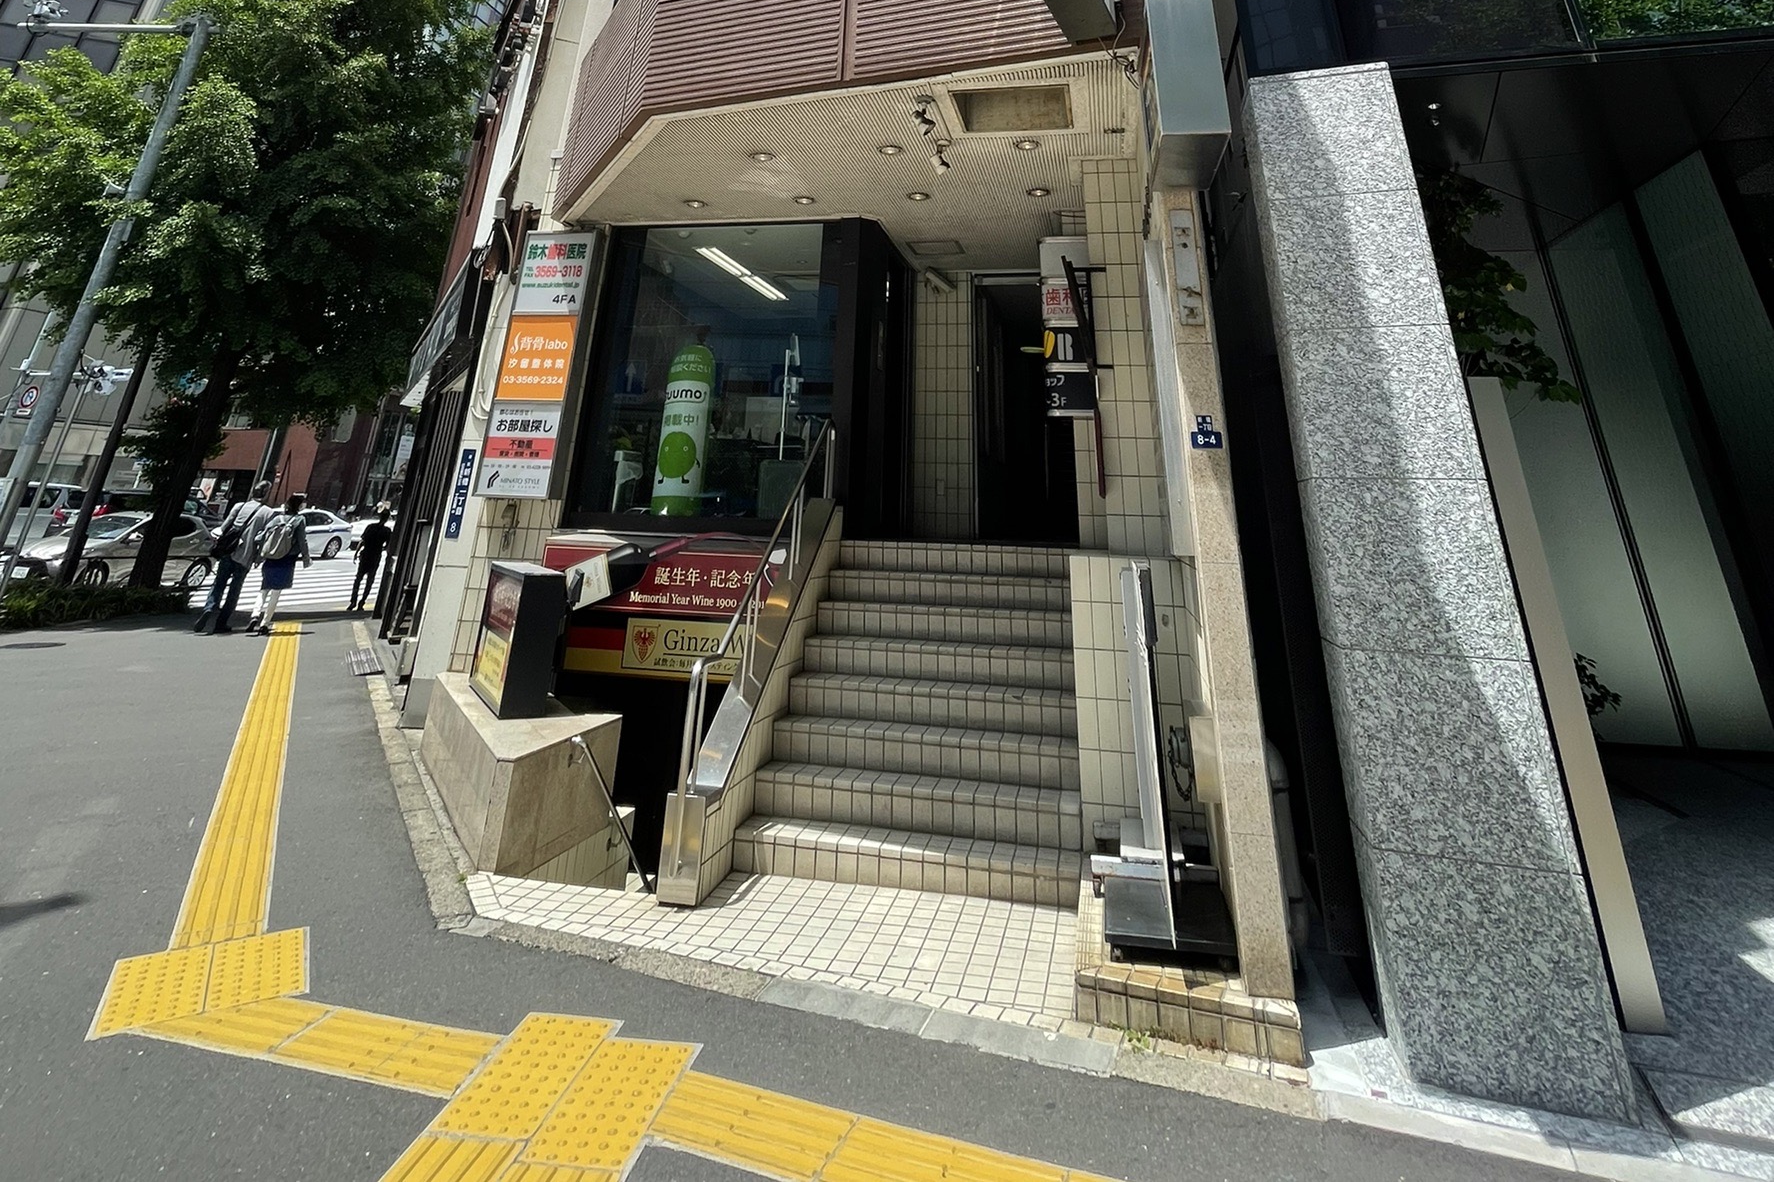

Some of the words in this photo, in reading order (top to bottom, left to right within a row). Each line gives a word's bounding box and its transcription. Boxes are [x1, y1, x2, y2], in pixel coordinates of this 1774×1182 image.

[527, 243, 588, 260] 鈴木歯科医院
[534, 265, 583, 278] 3569-3118
[520, 336, 568, 351] 背骨labo
[496, 419, 553, 433] お部屋探し
[1197, 434, 1217, 445] 8-4
[629, 591, 670, 604] Memorial
[671, 592, 690, 605] Year
[692, 595, 715, 606] Wine
[716, 598, 737, 608] 1900
[664, 629, 720, 653] Ginza
